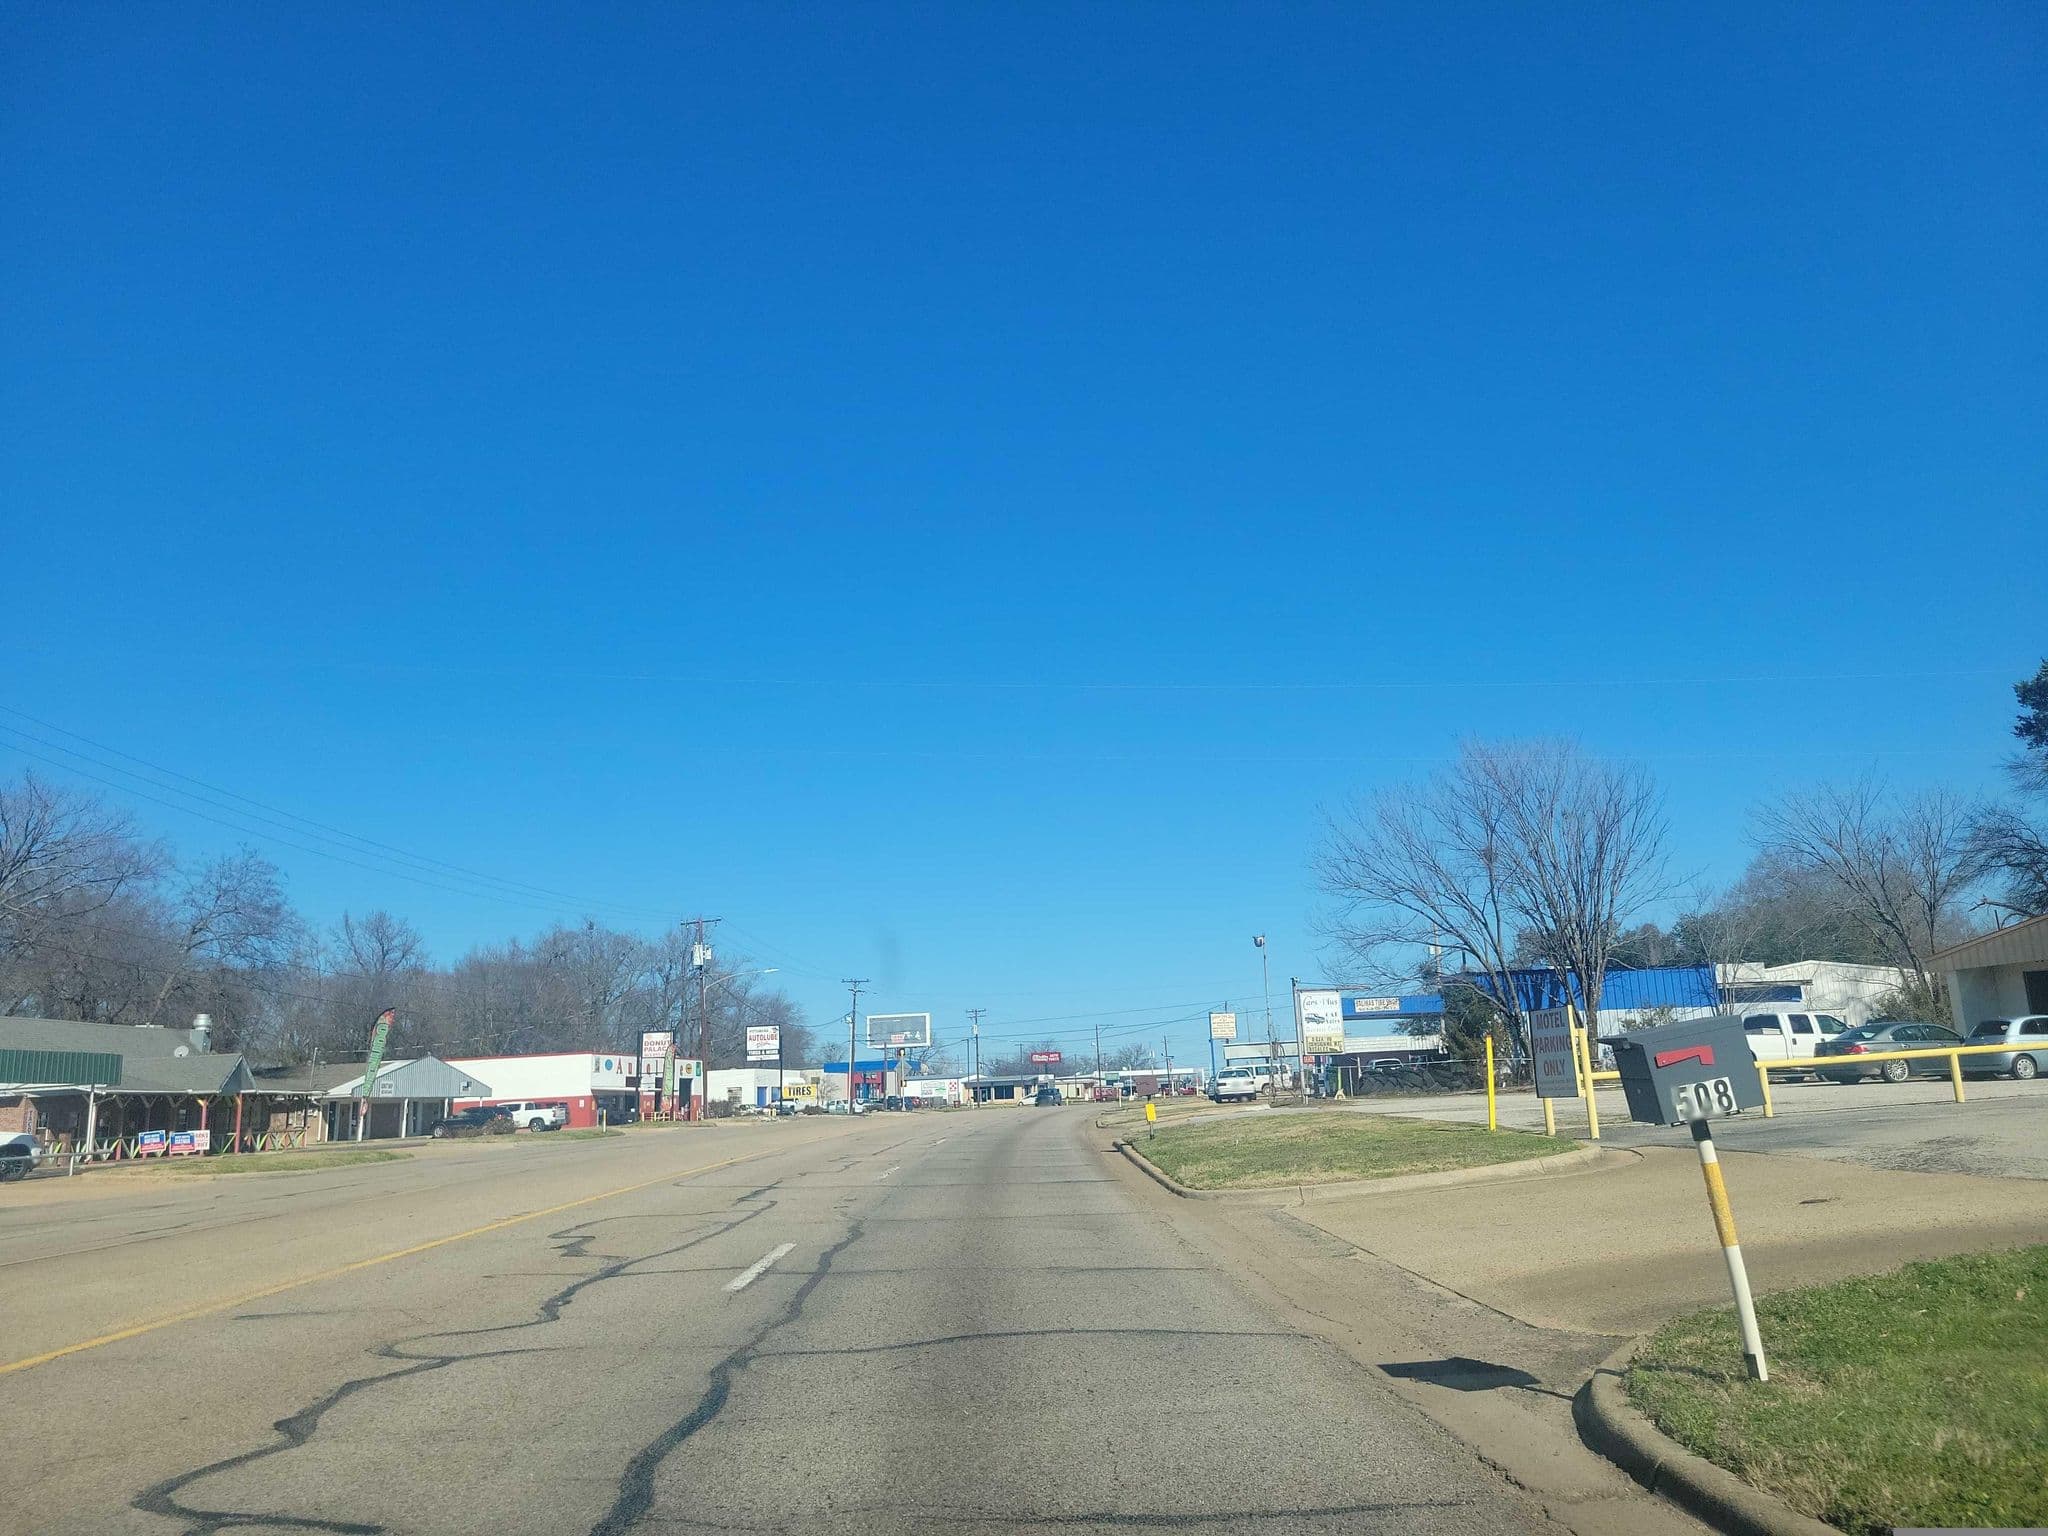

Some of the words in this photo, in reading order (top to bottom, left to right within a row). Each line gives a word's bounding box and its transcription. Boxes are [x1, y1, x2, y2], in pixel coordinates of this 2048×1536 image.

[1536, 1010, 1565, 1030] MOTEL
[749, 1033, 778, 1041] AUTOLUBE
[1534, 1034, 1572, 1053] PARKING
[1543, 1059, 1566, 1077] ONLY
[788, 1086, 812, 1097] TIRES
[1677, 1079, 1734, 1115] 508
